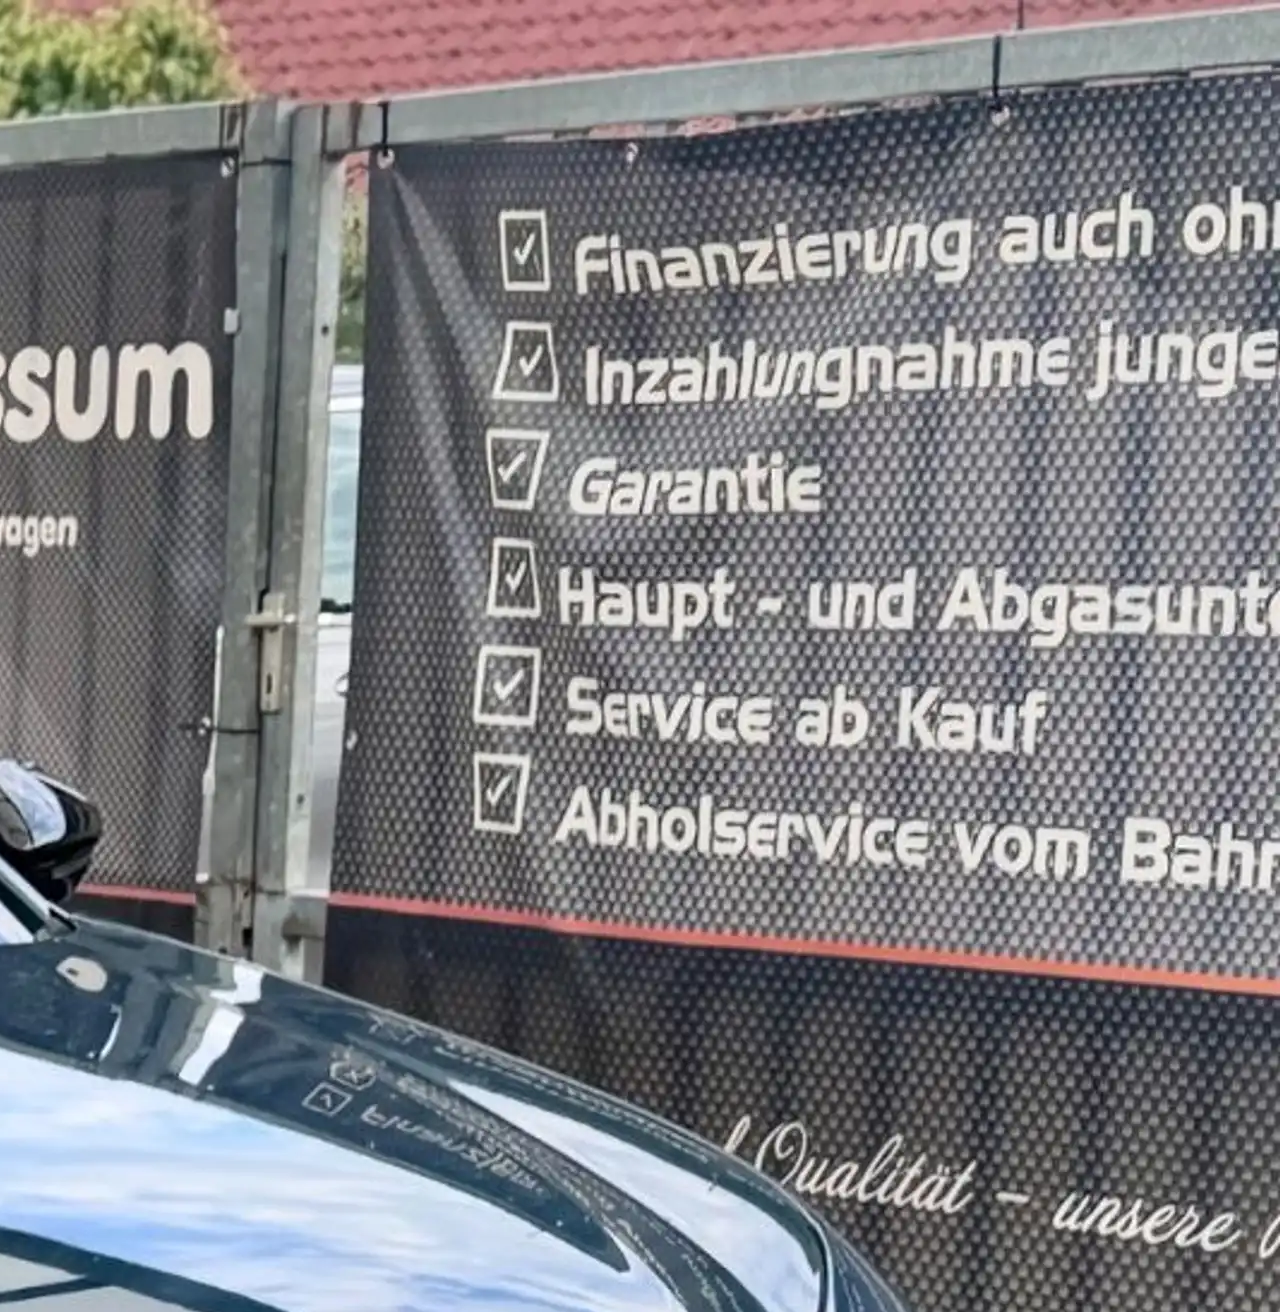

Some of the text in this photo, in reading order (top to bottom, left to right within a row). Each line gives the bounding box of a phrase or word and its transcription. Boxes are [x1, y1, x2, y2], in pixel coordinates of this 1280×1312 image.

[574, 217, 972, 295] Finanzierung
[999, 191, 1154, 262] auch
[586, 326, 1070, 408] Inzahlungnahme
[568, 455, 823, 516] Garantie
[559, 566, 735, 639] Haupt
[808, 568, 914, 631] und
[566, 677, 1045, 755] Service ab Kauf
[554, 786, 928, 868] Abholservice
[955, 818, 1090, 878] vom
[1052, 1191, 1243, 1252] unsere
